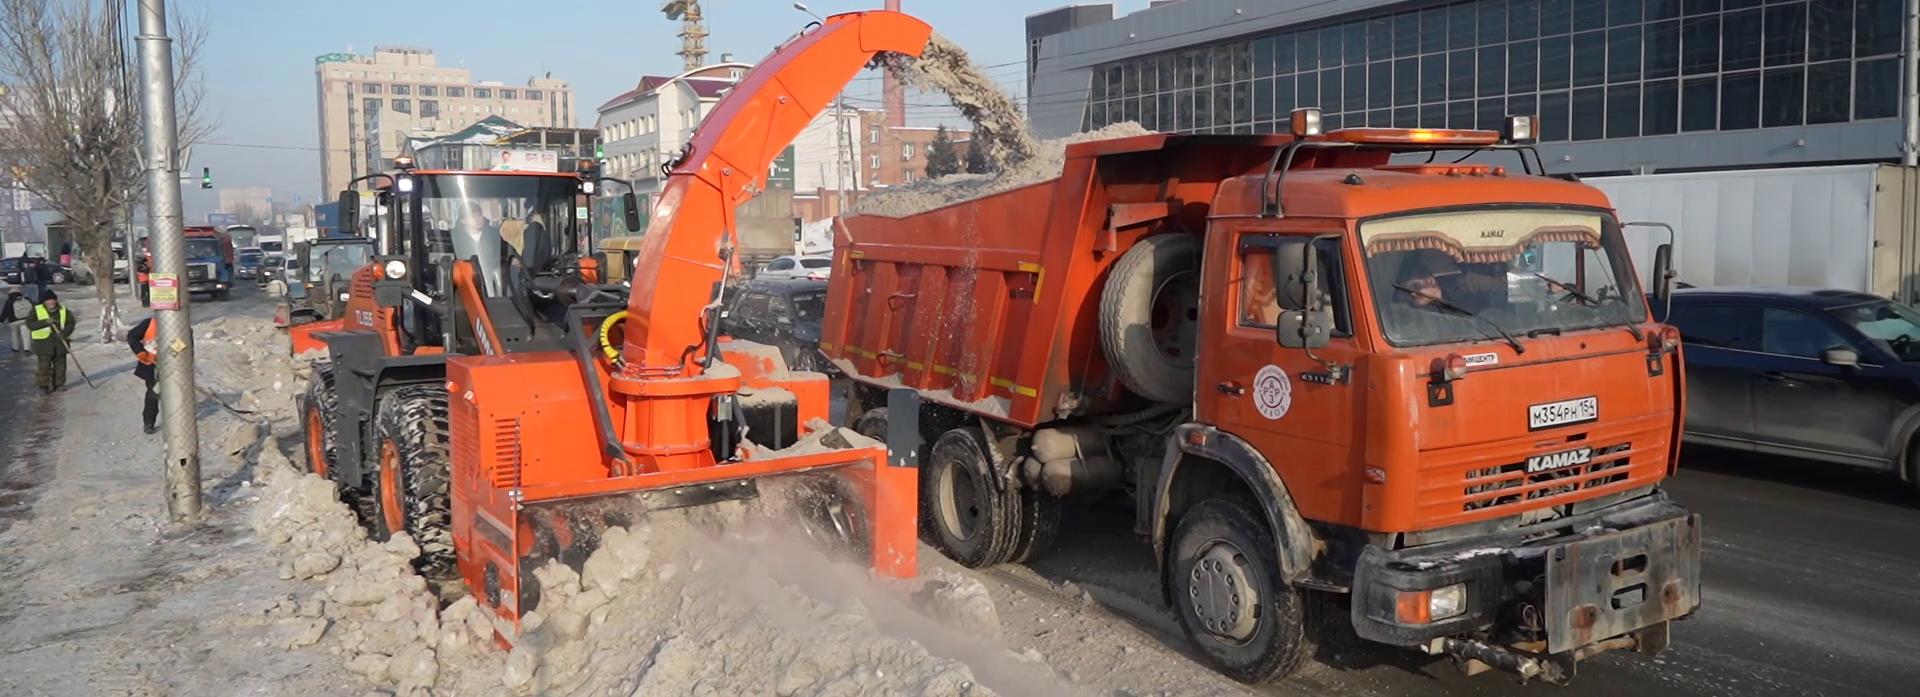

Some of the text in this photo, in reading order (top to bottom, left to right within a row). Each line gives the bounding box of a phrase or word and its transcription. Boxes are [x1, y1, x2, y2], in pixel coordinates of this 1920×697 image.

[1533, 400, 1595, 425] М354РН 154
[1528, 448, 1591, 473] KAMAZ
